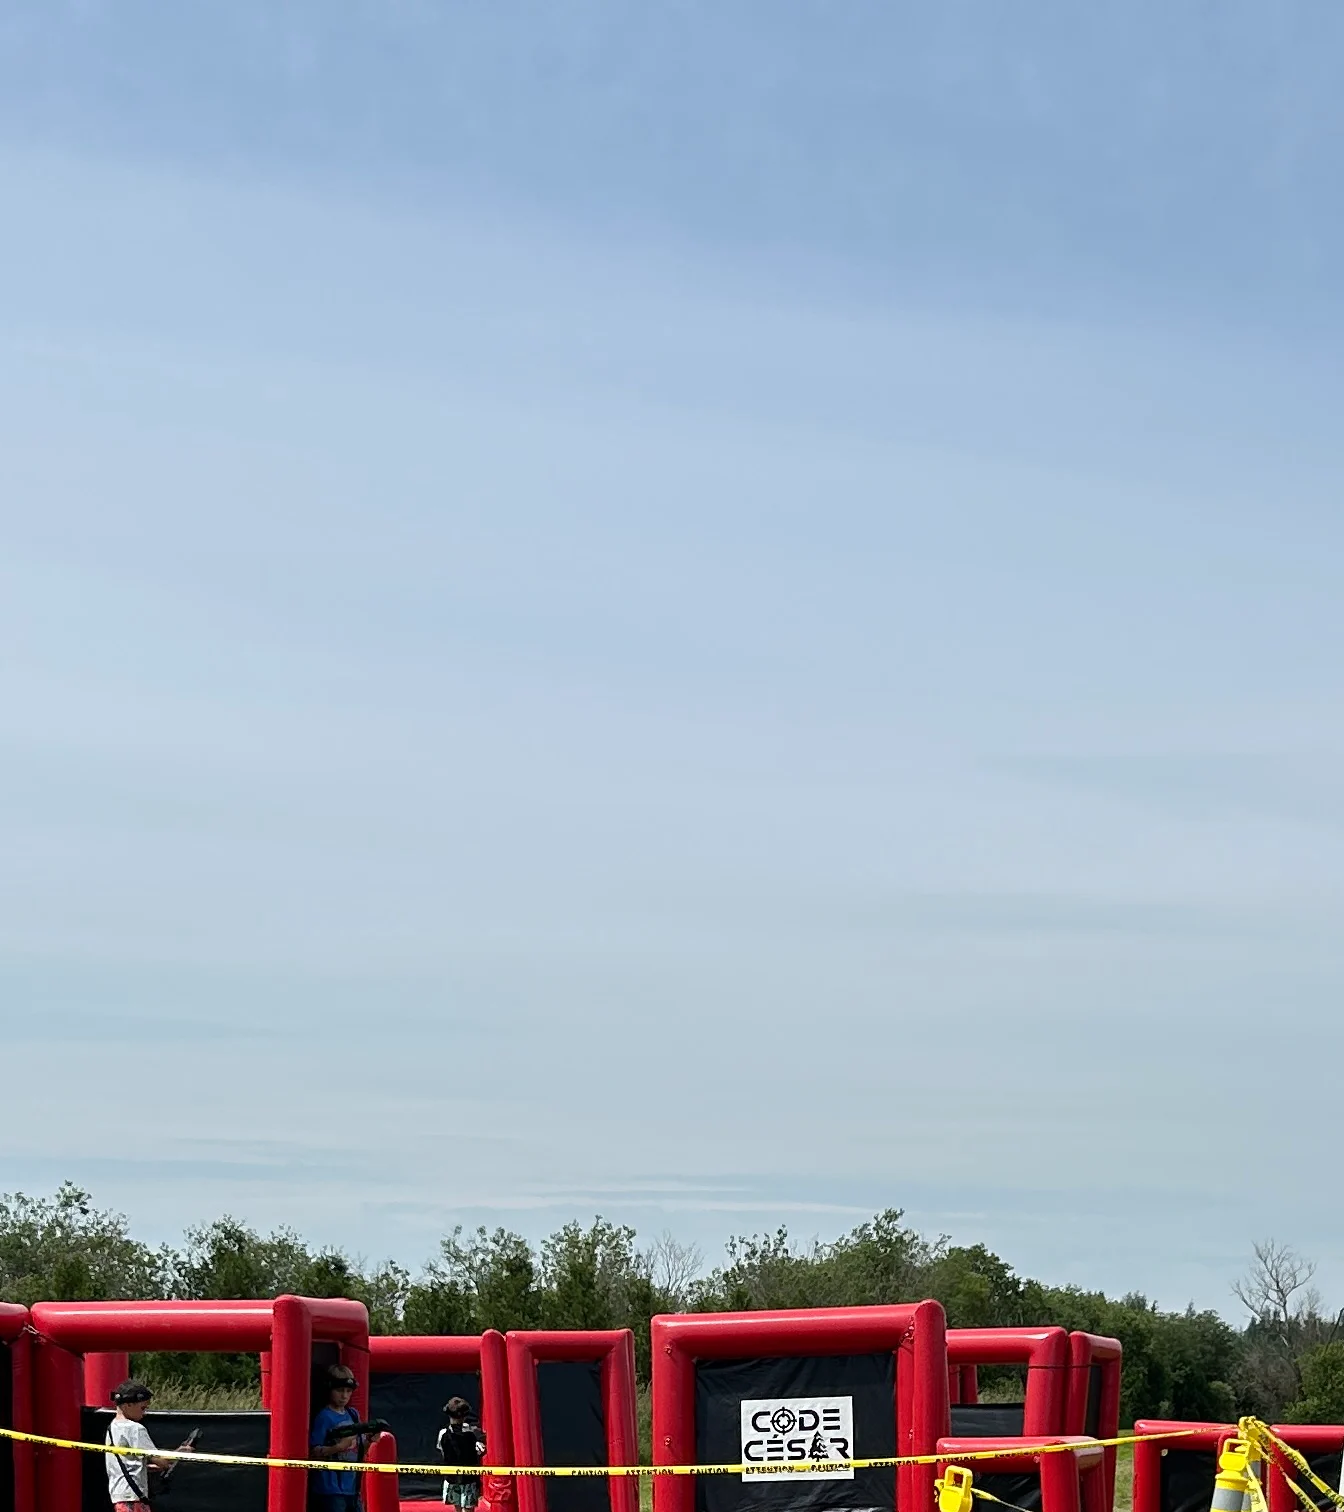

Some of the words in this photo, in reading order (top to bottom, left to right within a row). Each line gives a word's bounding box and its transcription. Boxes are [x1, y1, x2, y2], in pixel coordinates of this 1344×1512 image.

[751, 1407, 841, 1435] CODE
[743, 1431, 851, 1462] CÉSAR
[456, 1468, 493, 1476] CAUTION
[689, 1467, 729, 1475] CAUTION
